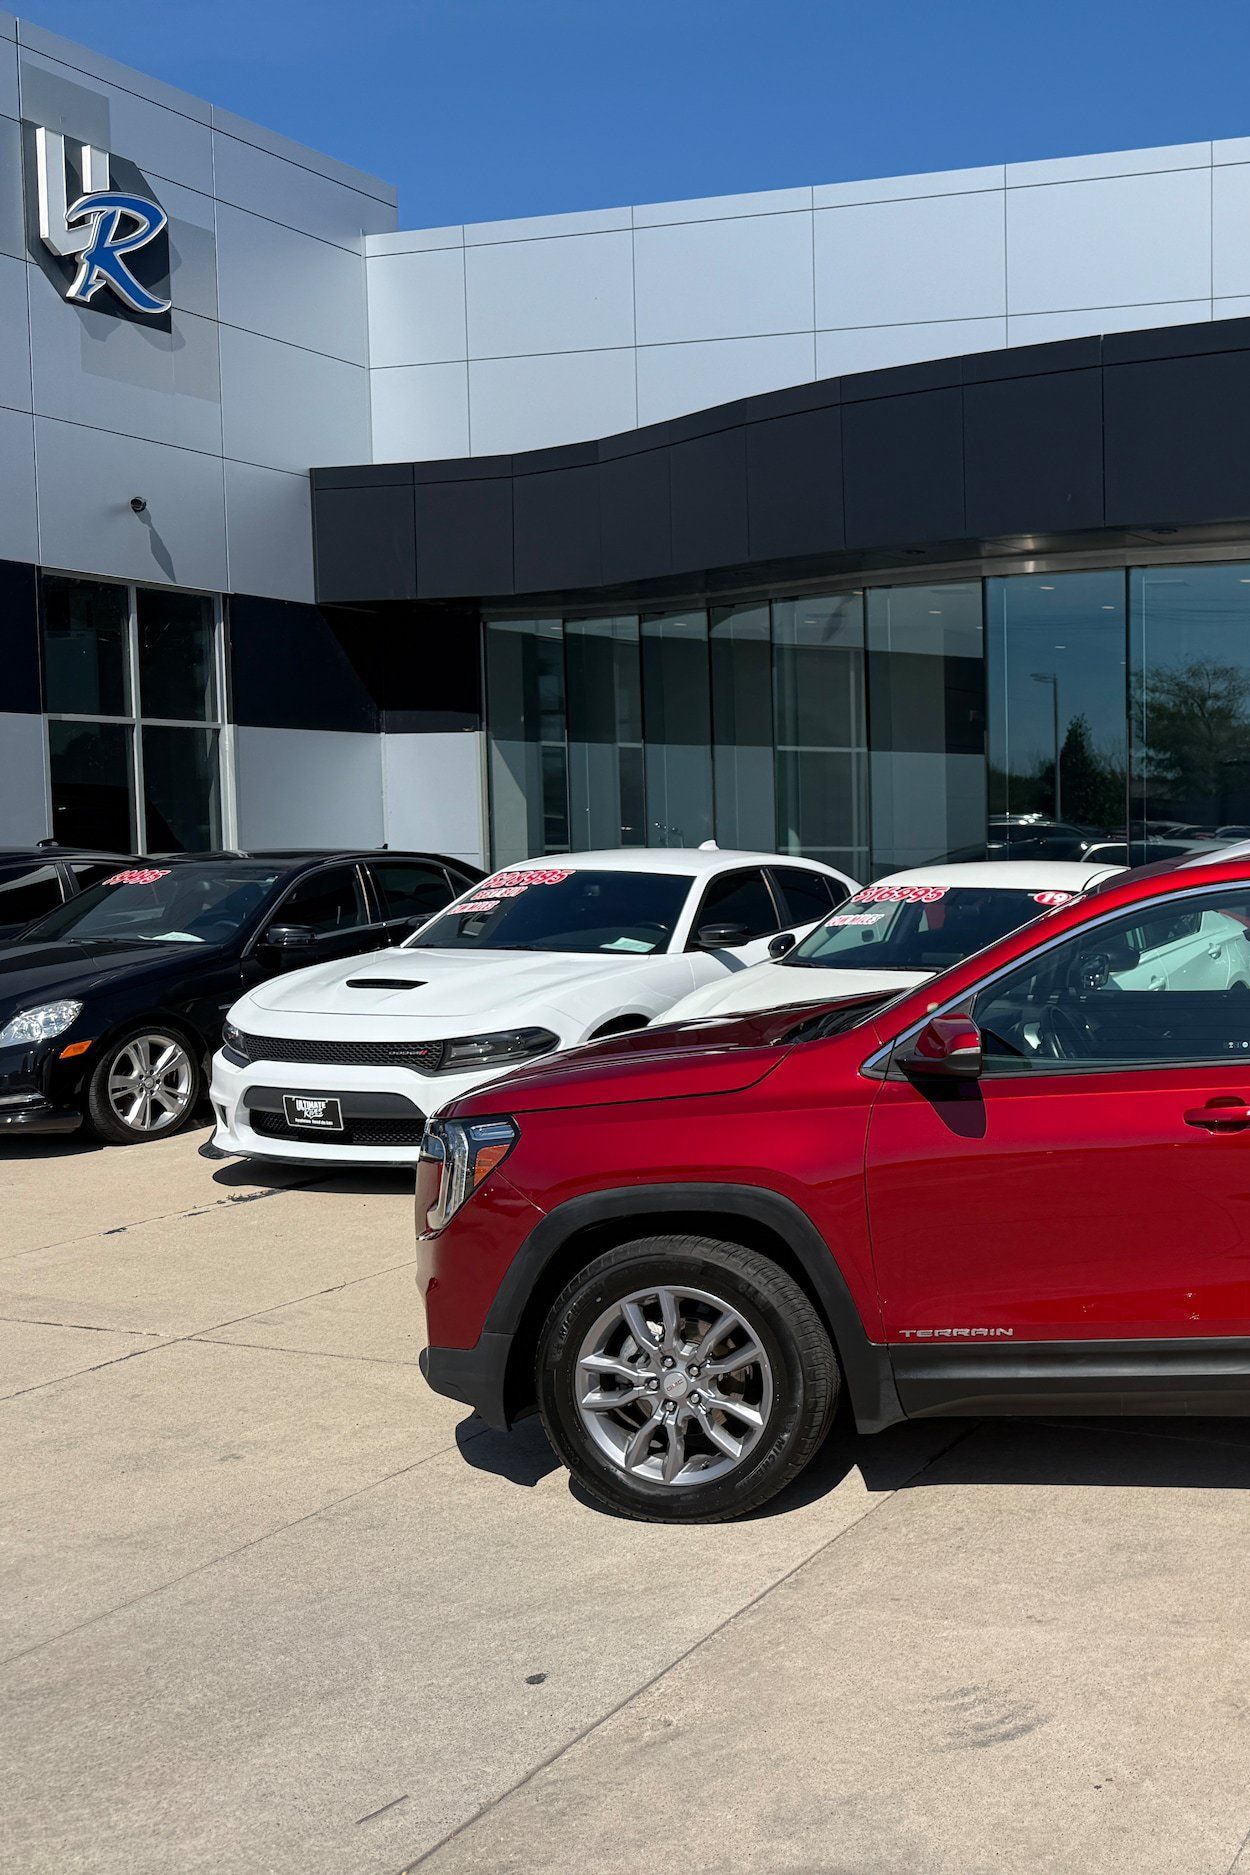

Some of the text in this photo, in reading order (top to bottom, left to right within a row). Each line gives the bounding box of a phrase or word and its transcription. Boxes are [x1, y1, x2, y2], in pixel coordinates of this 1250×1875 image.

[850, 887, 951, 903] $16995
[1041, 891, 1069, 903] 19
[295, 1099, 327, 1111] ULTIMATE
[898, 1328, 1014, 1338] TERRAIN
